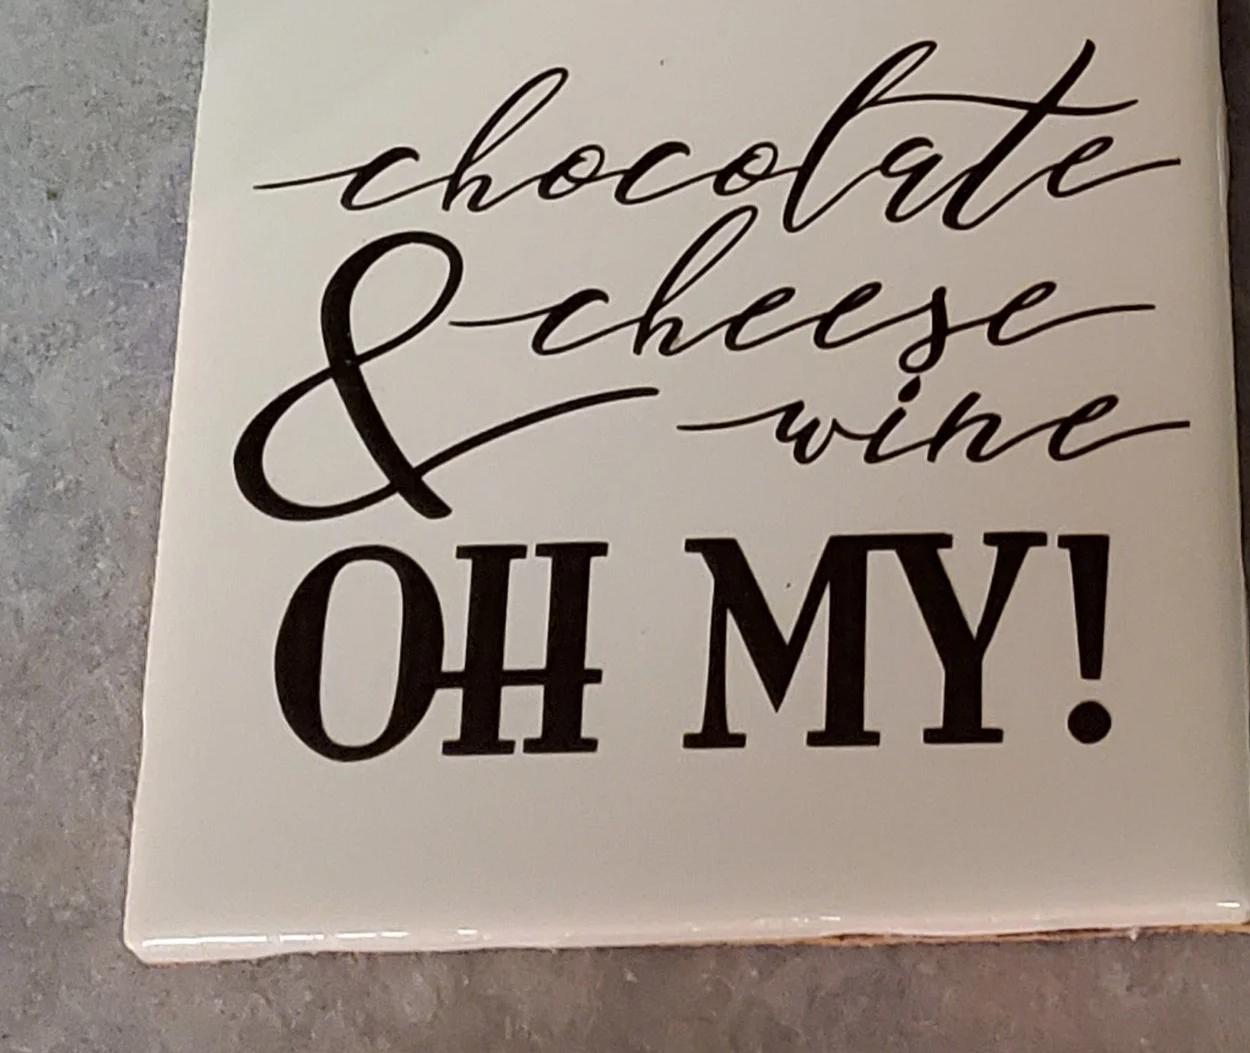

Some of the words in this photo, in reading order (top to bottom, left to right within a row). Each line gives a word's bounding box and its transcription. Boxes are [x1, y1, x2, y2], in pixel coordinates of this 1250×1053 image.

[253, 38, 1183, 234] chocolate
[233, 231, 660, 522] &
[449, 204, 1156, 374] cheese
[676, 375, 1192, 465] wine
[274, 541, 610, 763] OH
[682, 531, 1113, 750] MY!
